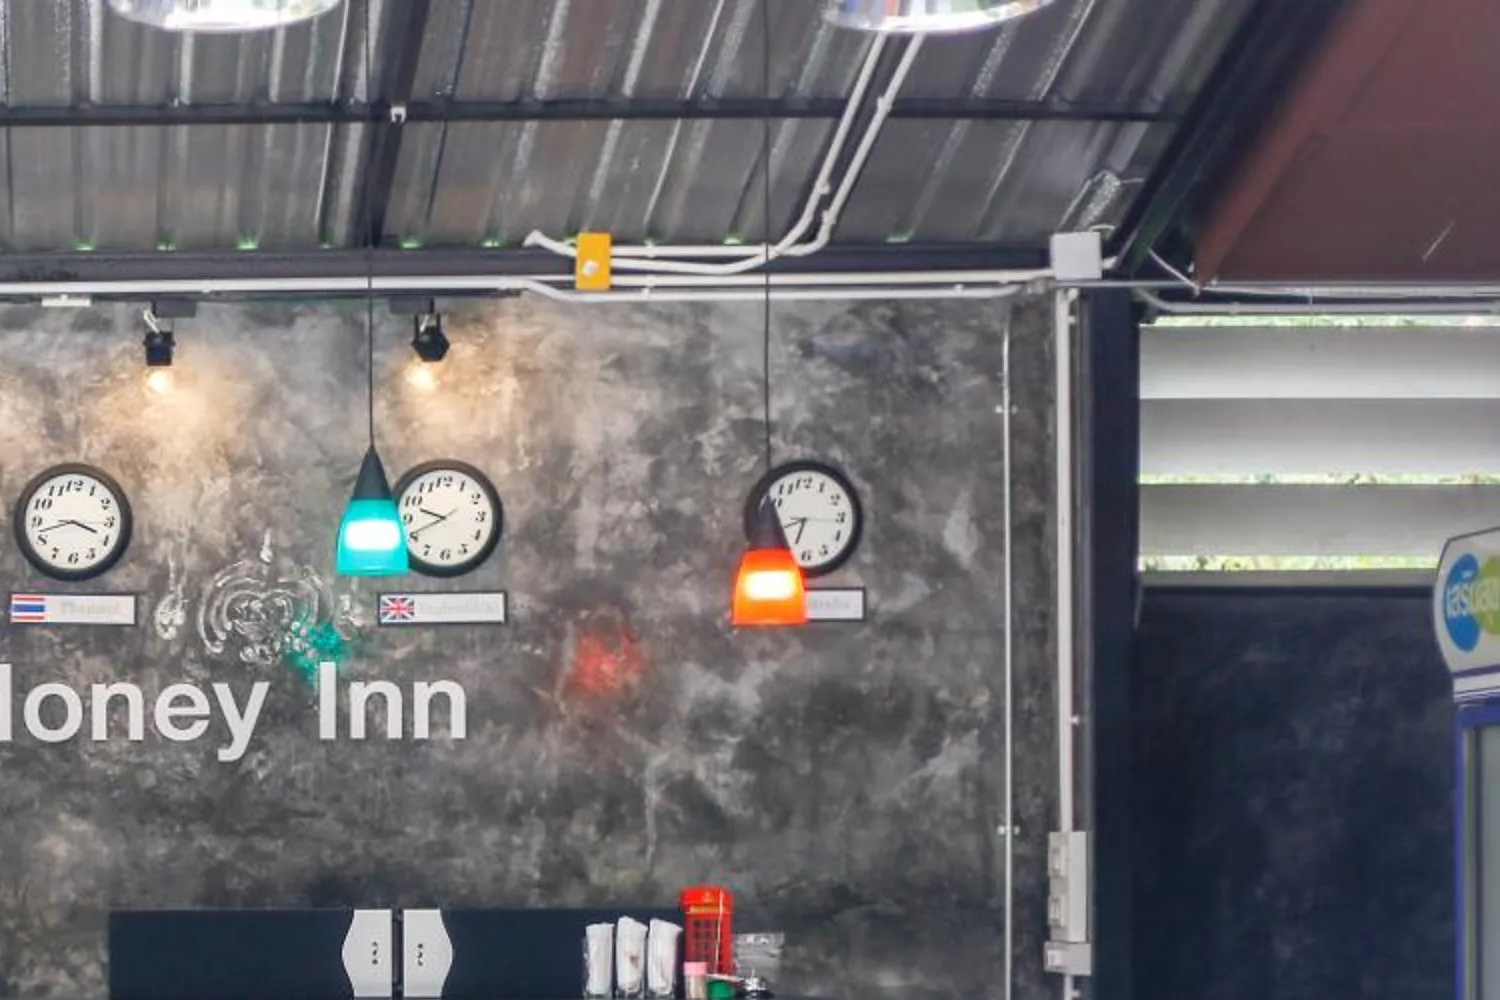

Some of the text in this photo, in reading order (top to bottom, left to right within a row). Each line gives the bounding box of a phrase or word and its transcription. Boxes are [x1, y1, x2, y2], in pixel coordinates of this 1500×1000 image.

[65, 479, 84, 492] 12
[419, 481, 435, 493] 11
[436, 475, 453, 488] 12
[795, 476, 813, 490] 12
[48, 485, 65, 497] 11
[778, 483, 794, 495] 11
[34, 498, 53, 510] 10
[100, 497, 111, 511] 2
[404, 495, 424, 507] 10
[470, 493, 481, 506] 2
[829, 493, 841, 507] 2
[31, 516, 43, 529] 9
[103, 515, 115, 529] 3
[403, 513, 414, 525] 9
[474, 510, 486, 523] 3
[835, 511, 846, 523] 3
[101, 534, 110, 547] 4
[470, 528, 481, 541] 4
[833, 529, 842, 542] 4
[85, 547, 97, 560] 5
[440, 548, 452, 560] 6
[457, 543, 469, 555] 5
[801, 549, 812, 561] 6
[819, 544, 829, 556] 5
[67, 551, 79, 564] 6
[319, 661, 467, 740] Inn
